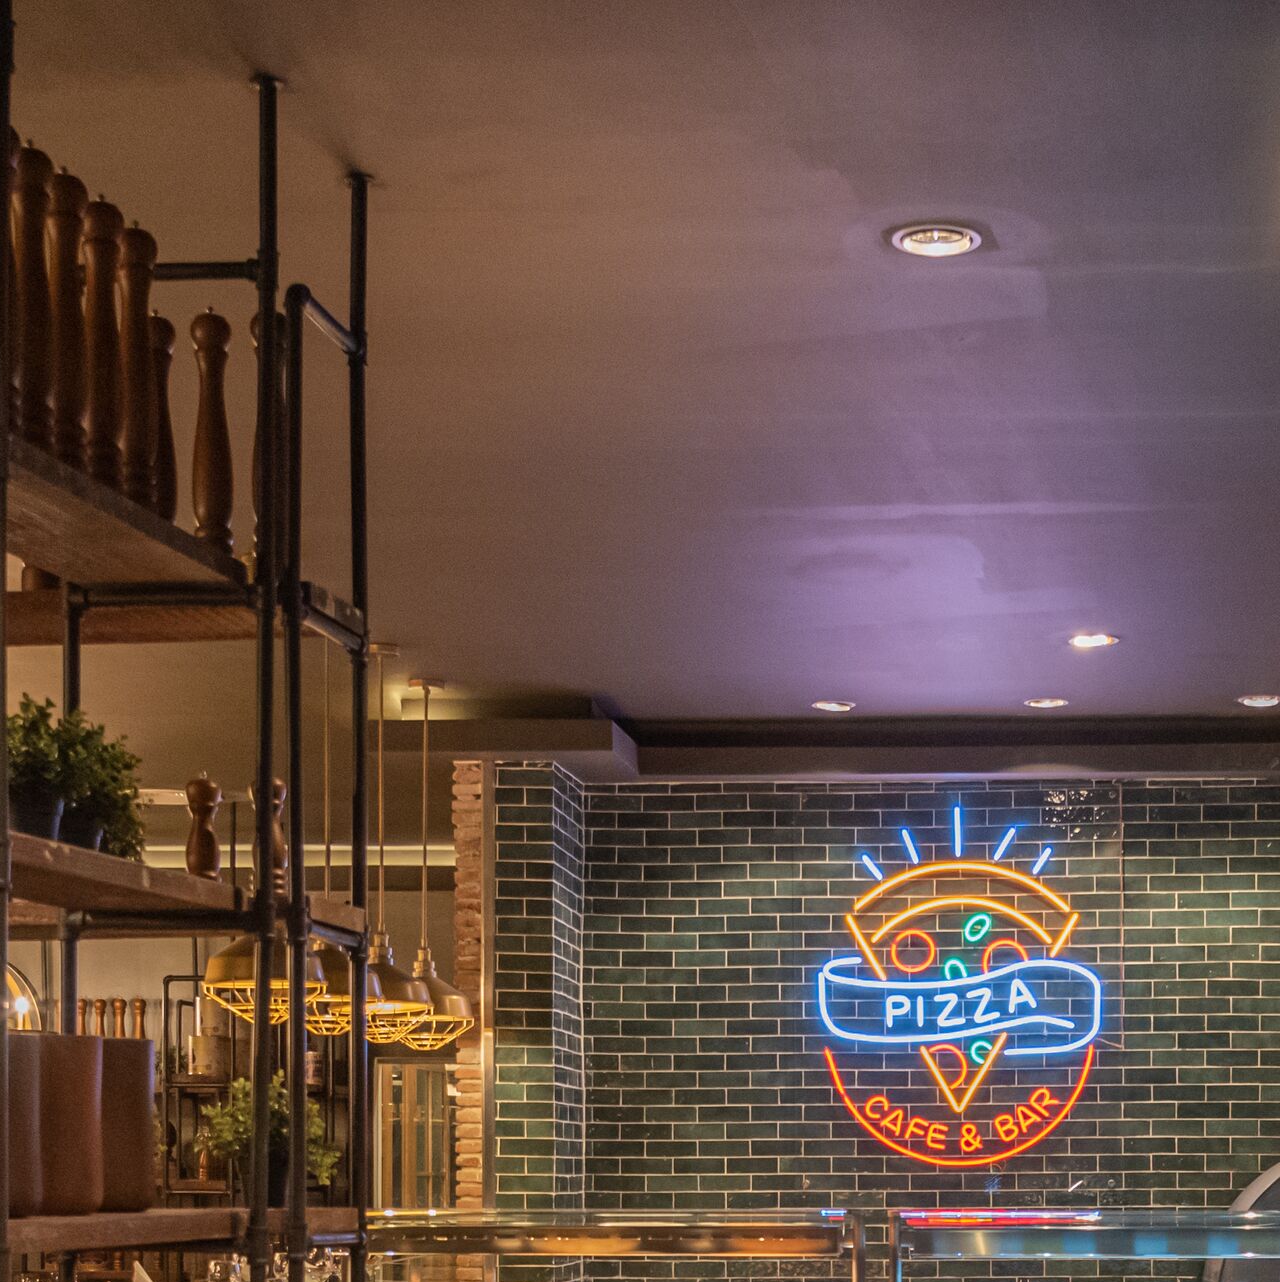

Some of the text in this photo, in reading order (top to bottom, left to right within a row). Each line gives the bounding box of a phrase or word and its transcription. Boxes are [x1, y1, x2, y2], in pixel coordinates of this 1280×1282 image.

[885, 977, 1038, 1029] PIZZA
[863, 1086, 1060, 1153] CAFE & BAR
